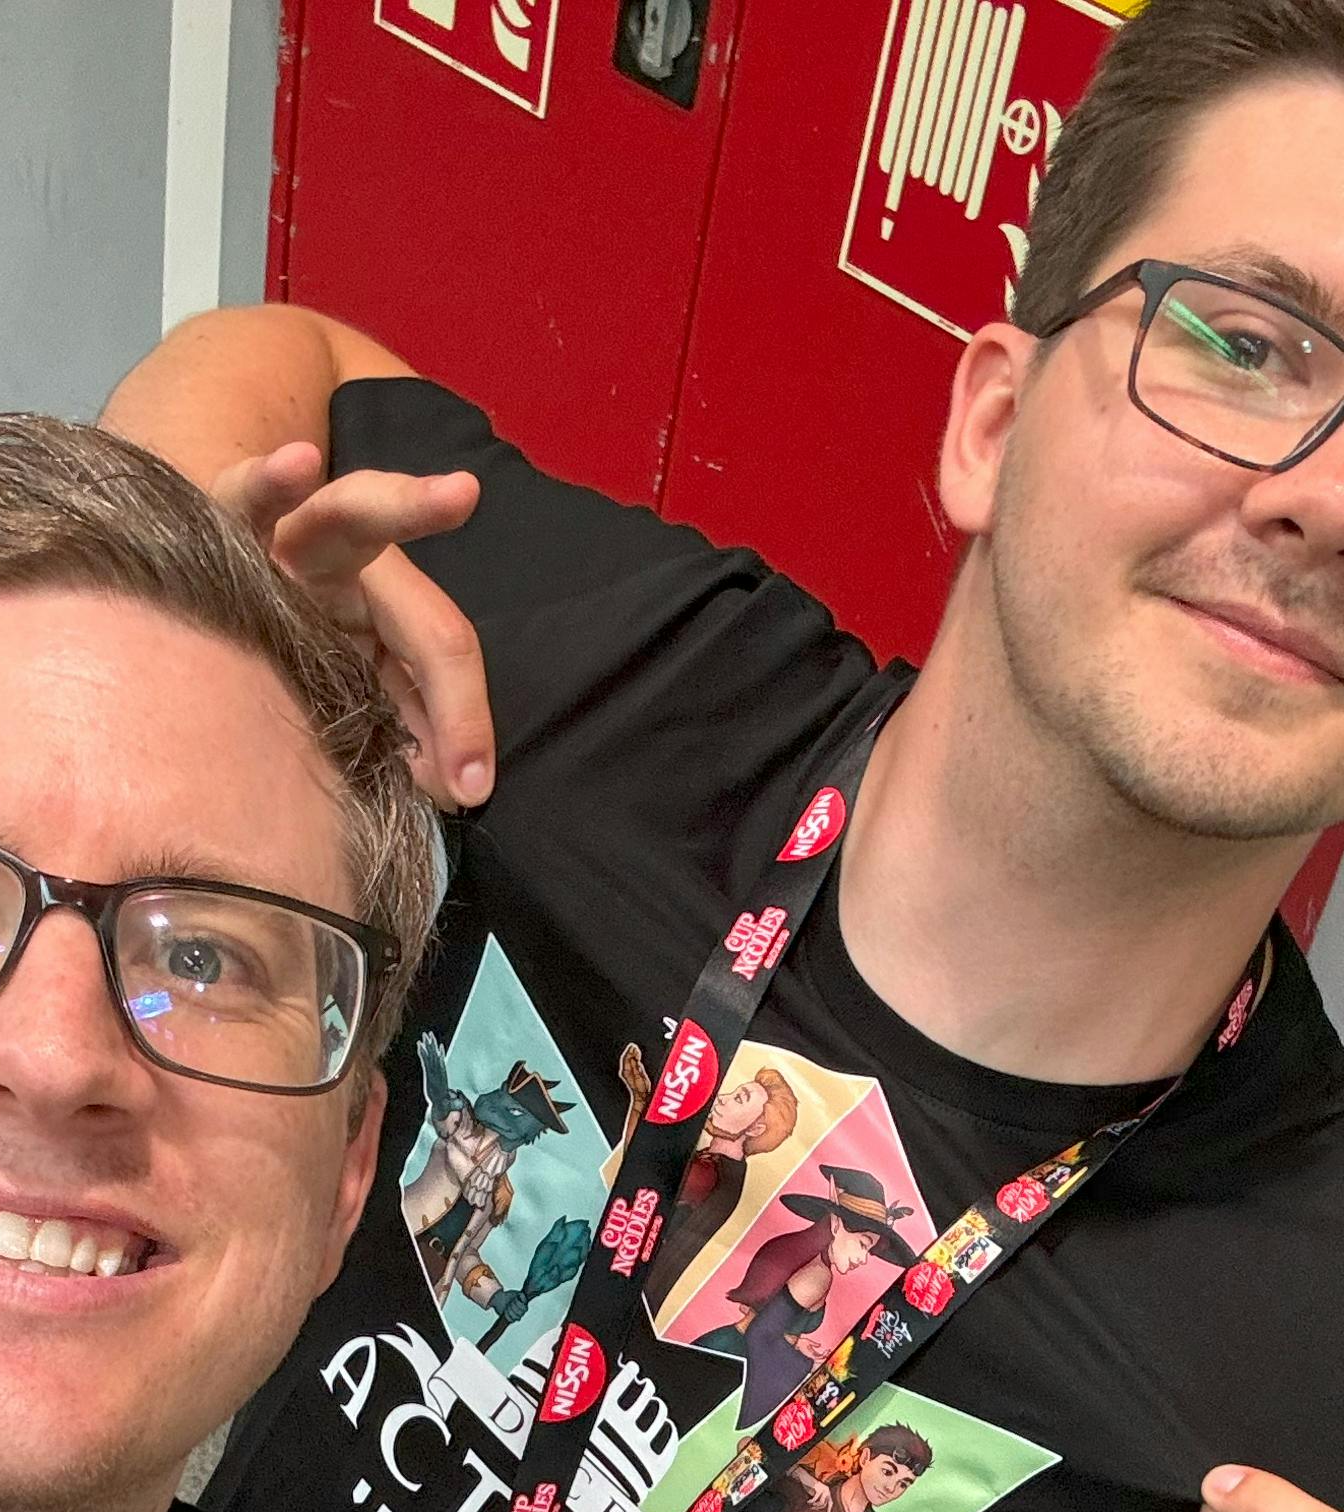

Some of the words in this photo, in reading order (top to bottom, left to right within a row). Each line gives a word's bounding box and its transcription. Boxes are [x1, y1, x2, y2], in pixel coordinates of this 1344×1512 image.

[790, 792, 836, 857] NISSIN
[724, 912, 759, 952] CUP
[732, 906, 787, 981] NOODLES
[658, 1035, 707, 1120] NISSIN
[600, 1198, 631, 1249] CUP
[610, 1187, 660, 1278] NOODLES
[551, 1336, 594, 1416] NISSIN
